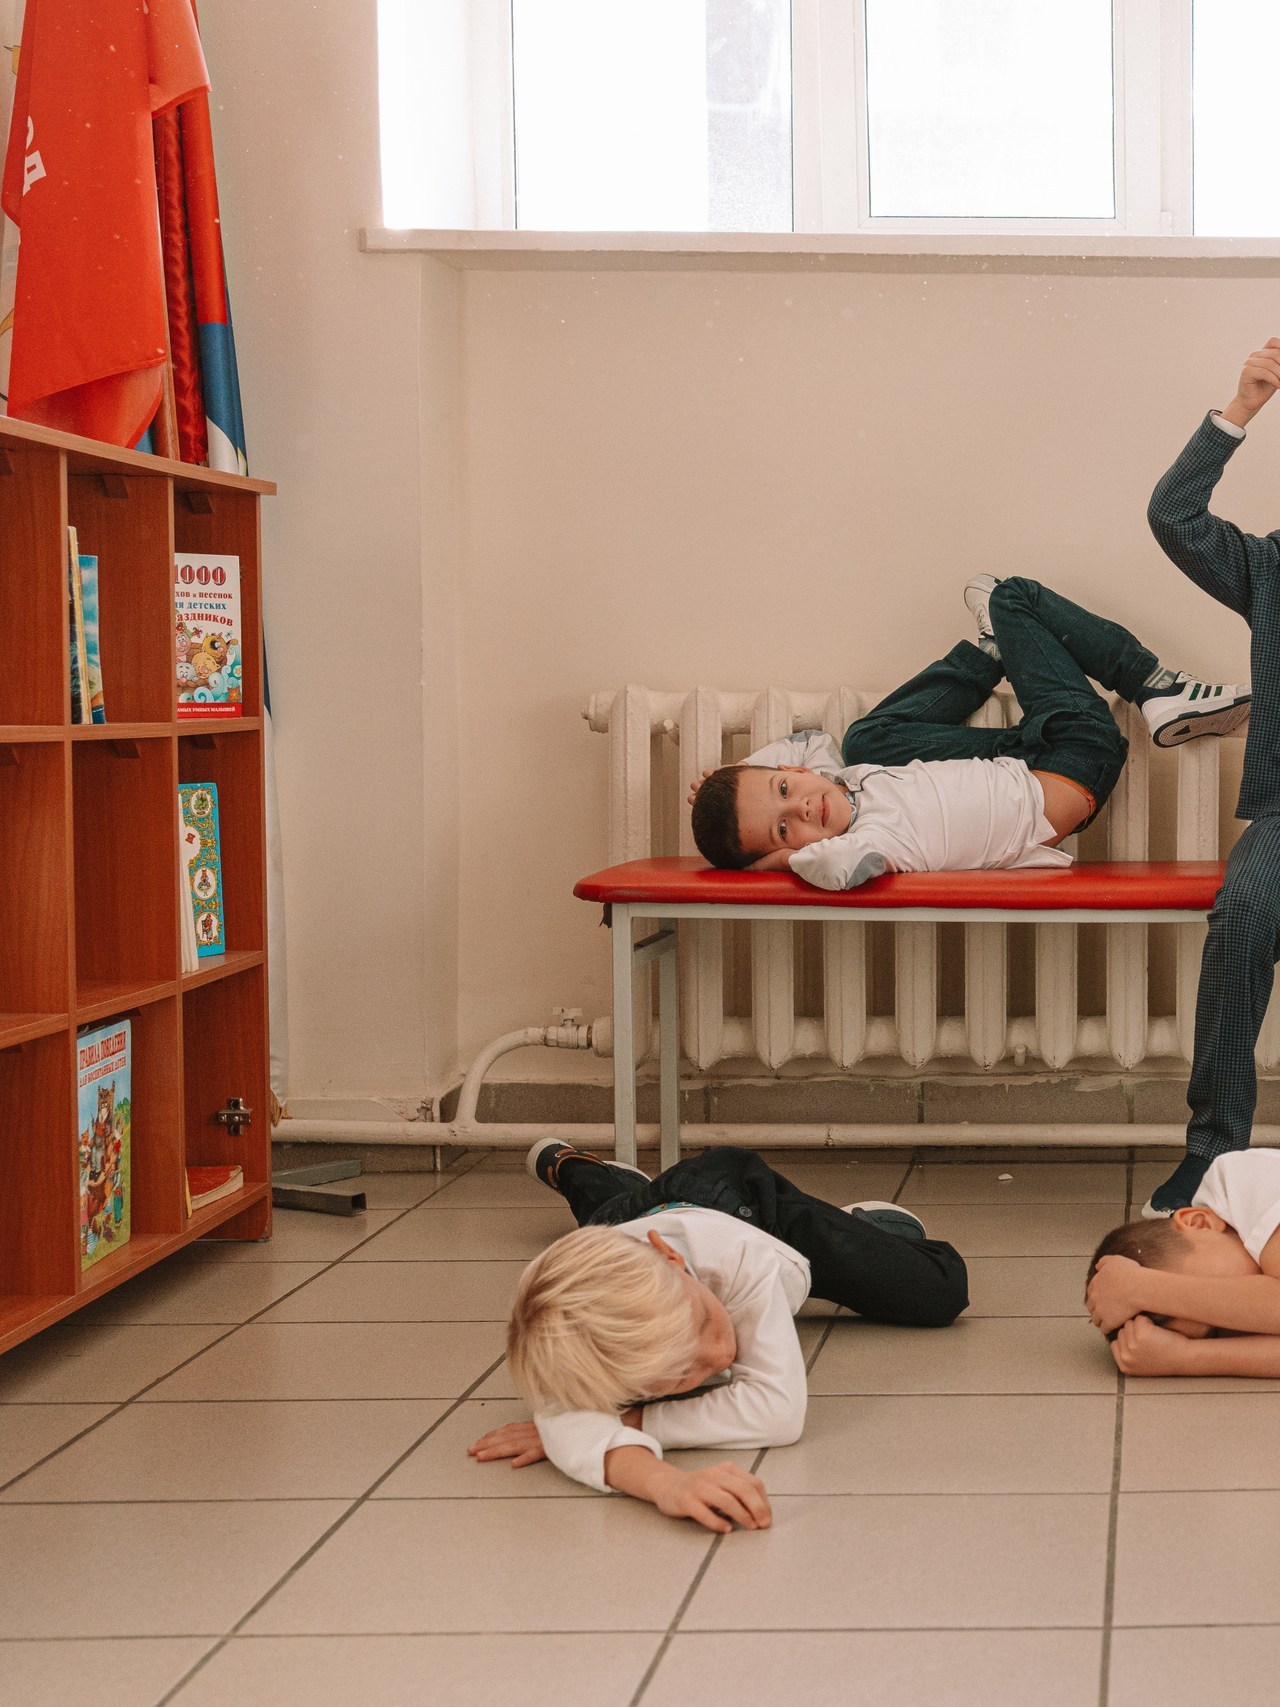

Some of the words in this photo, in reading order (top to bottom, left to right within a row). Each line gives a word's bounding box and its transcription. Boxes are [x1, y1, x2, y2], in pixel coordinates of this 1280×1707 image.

[199, 591, 233, 599] песенок
[187, 602, 227, 610] детских
[177, 612, 233, 626] аздников
